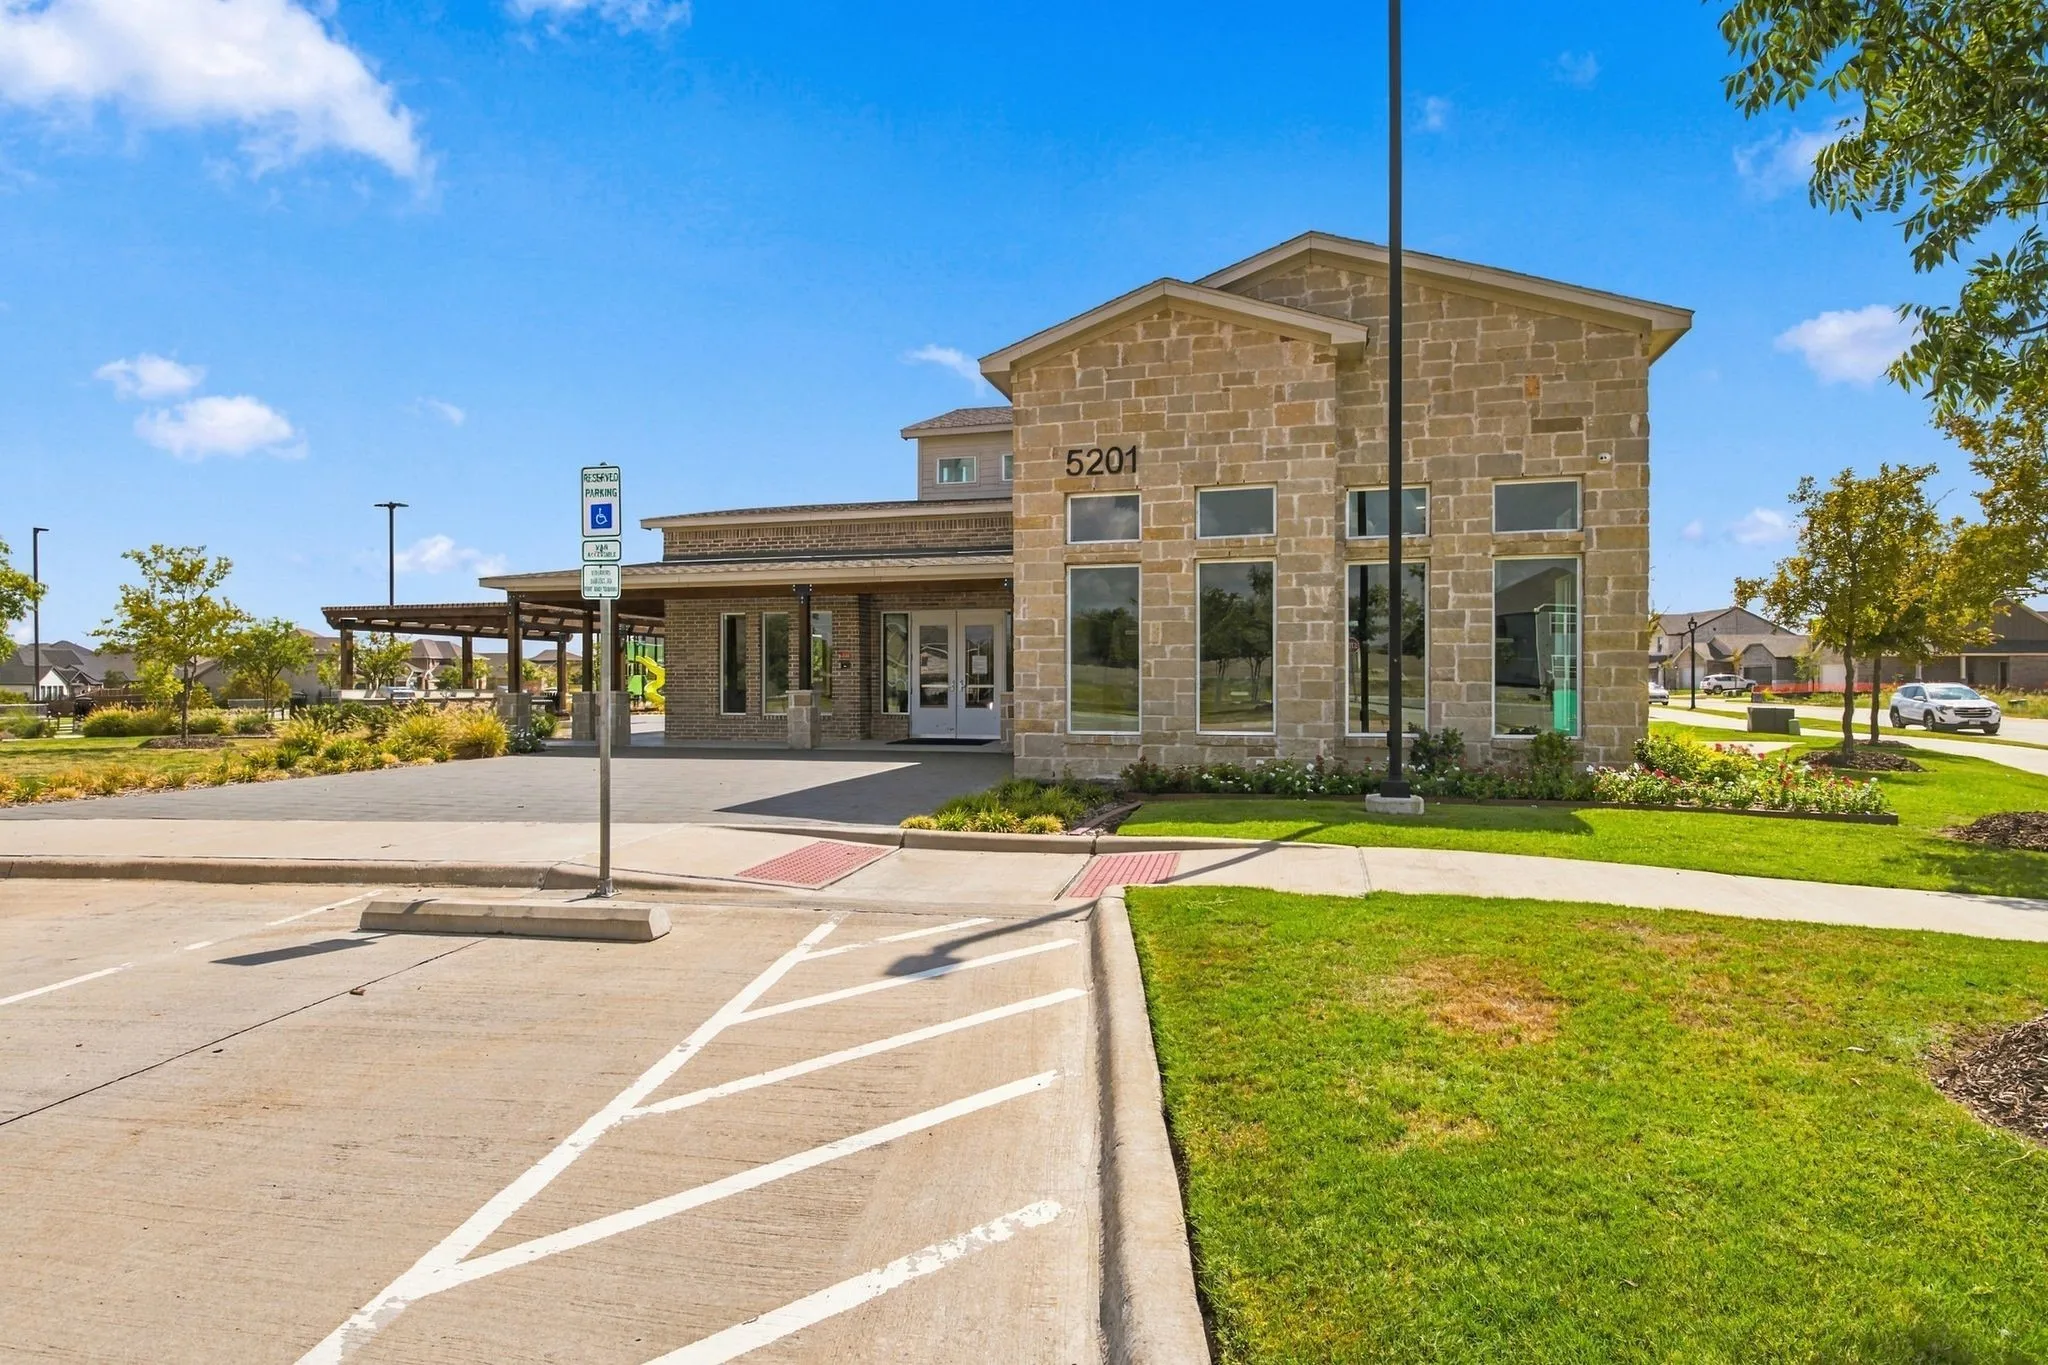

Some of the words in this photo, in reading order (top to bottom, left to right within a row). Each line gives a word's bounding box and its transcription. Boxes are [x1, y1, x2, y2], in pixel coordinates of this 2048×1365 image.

[1066, 445, 1136, 476] 5201
[584, 473, 619, 482] RESERVED
[585, 488, 617, 497] PARKING
